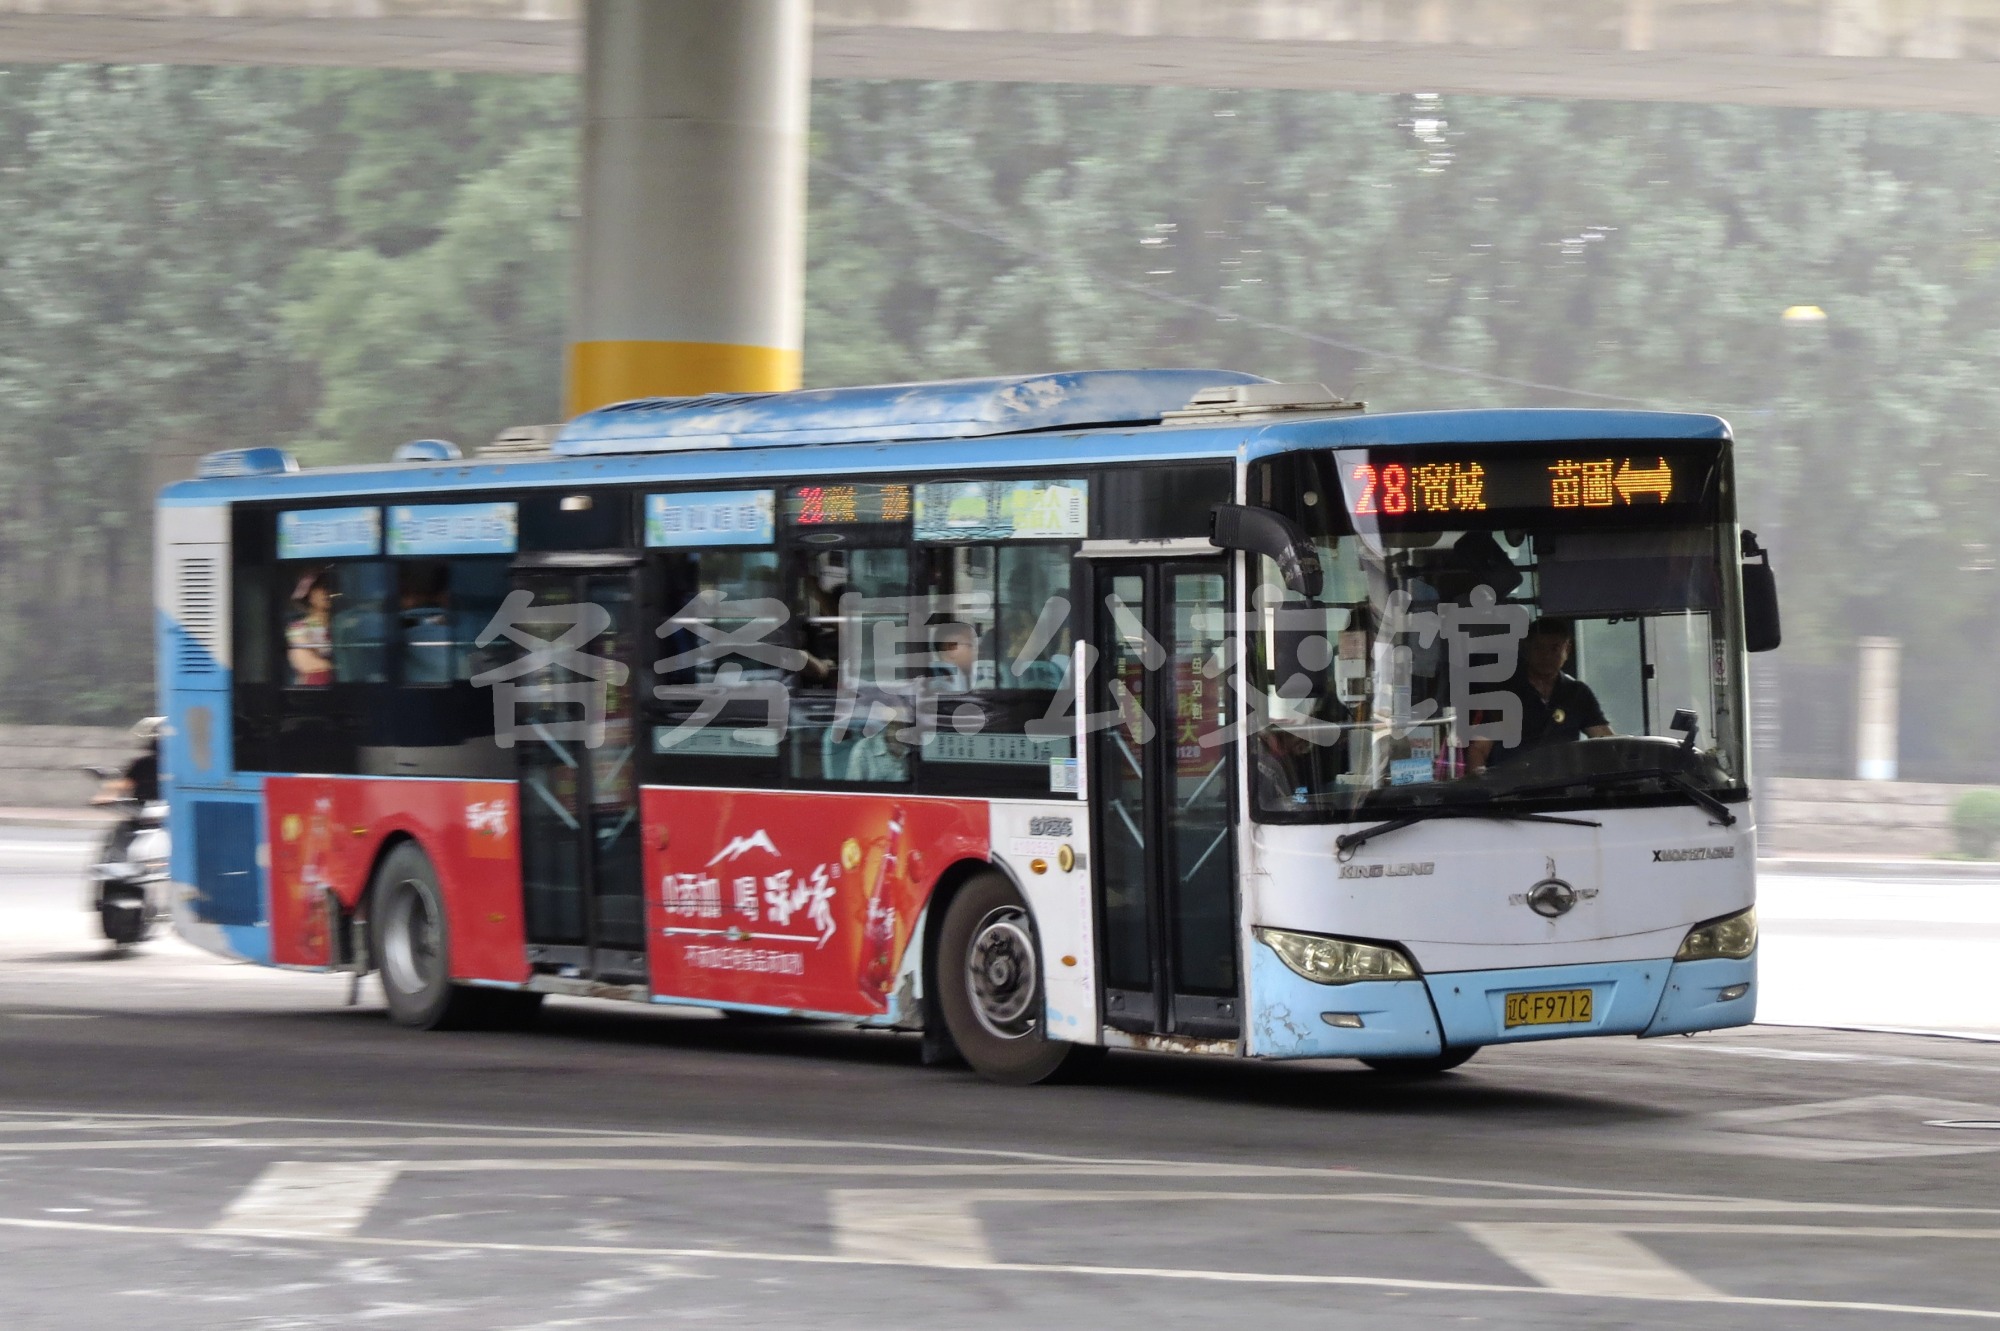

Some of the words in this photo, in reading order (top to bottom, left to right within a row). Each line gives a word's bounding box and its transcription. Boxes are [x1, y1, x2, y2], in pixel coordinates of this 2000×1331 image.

[1353, 464, 1407, 514] 28
[1338, 864, 1384, 879] KING
[1386, 861, 1435, 877] LONG
